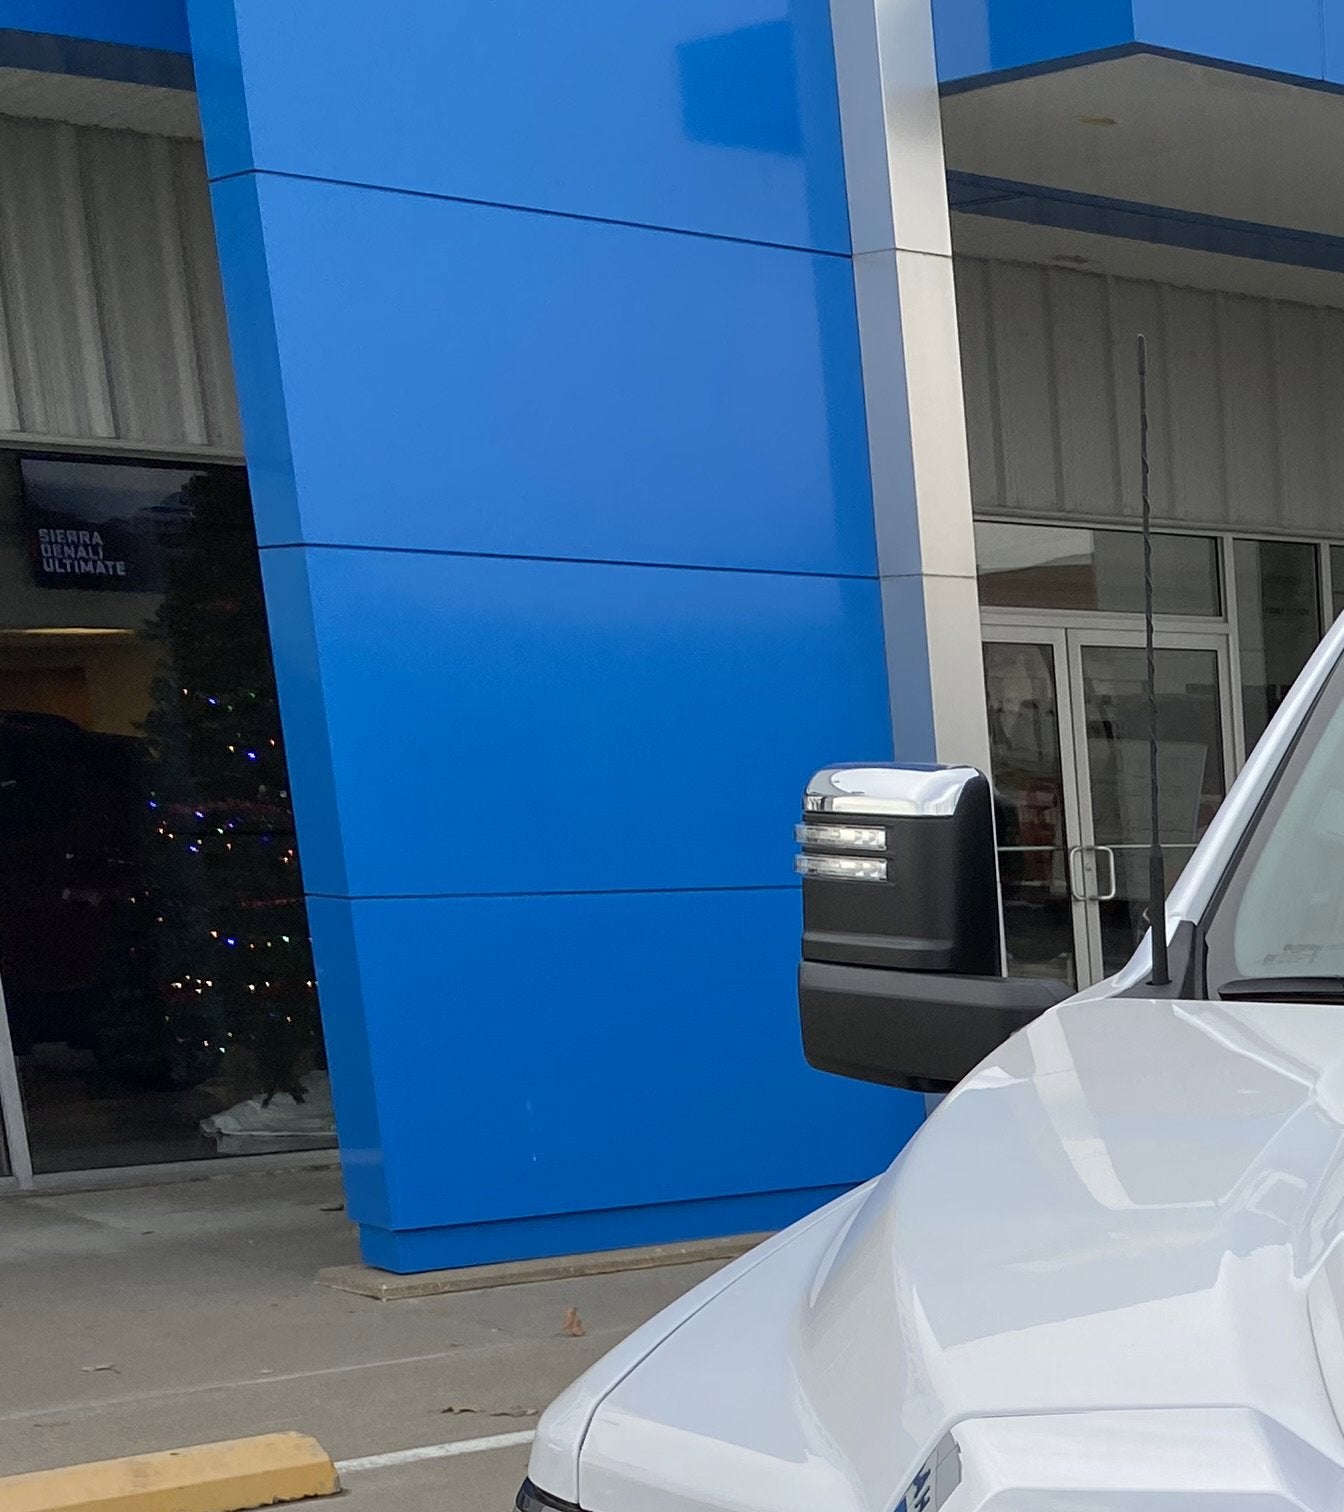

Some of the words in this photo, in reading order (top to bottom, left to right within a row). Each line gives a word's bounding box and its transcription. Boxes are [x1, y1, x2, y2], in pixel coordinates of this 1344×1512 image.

[38, 528, 104, 546] SIERRA
[40, 543, 104, 561] DENALI
[43, 558, 127, 576] ULTIMATE
